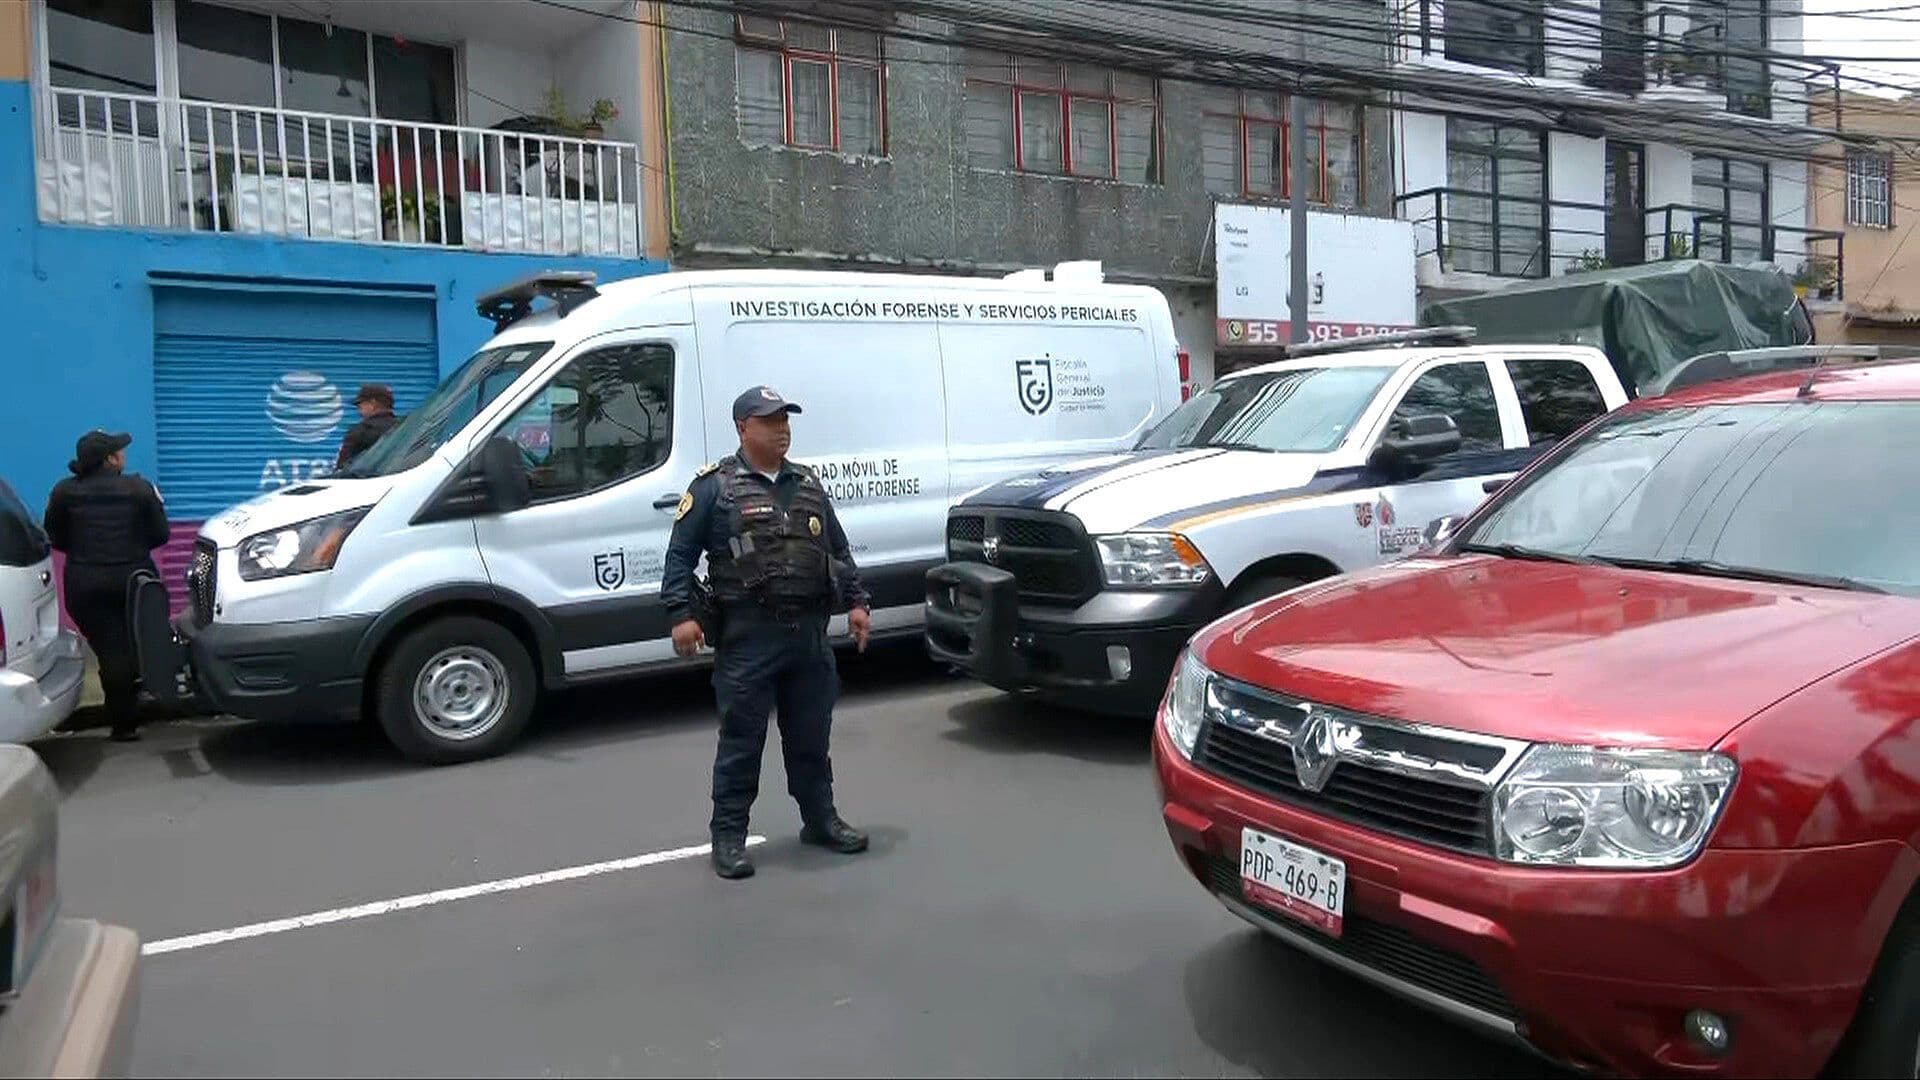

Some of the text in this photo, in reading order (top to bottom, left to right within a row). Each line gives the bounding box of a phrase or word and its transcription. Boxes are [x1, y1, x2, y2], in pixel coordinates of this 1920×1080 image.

[730, 299, 1138, 322] INVESTIGACIÓN FORENSE Y SERVICIOS PERICIALES
[1247, 323, 1279, 344] 55
[842, 457, 879, 479] MÓVIL
[883, 459, 898, 476] DE
[868, 478, 920, 497] FORENSE
[1244, 848, 1338, 910] PDP-469-B
